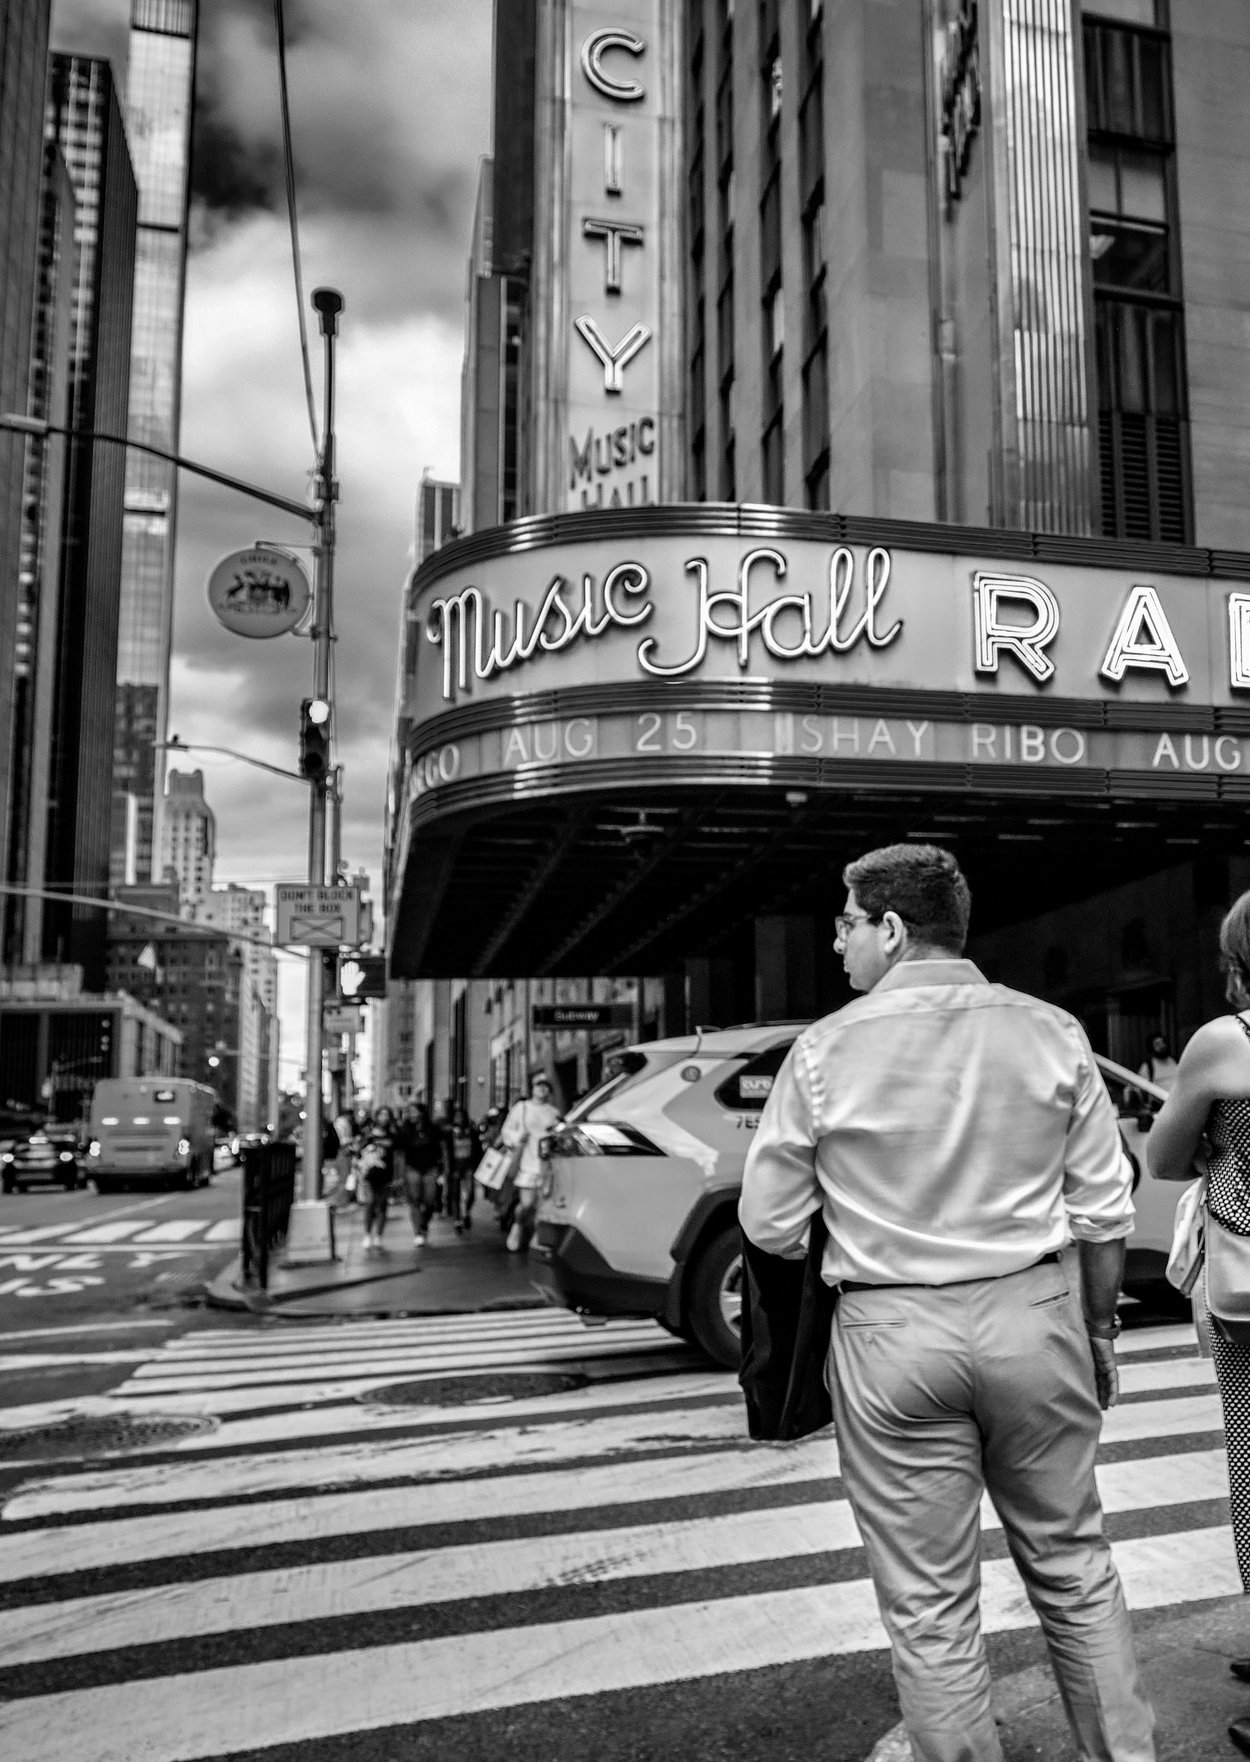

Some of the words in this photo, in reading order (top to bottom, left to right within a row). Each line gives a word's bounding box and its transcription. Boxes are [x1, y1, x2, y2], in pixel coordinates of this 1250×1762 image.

[575, 27, 653, 394] CITY
[426, 562, 653, 699] Music
[638, 547, 903, 676] Hall
[503, 717, 593, 769] AUG
[637, 713, 698, 753] 25
[971, 721, 1085, 765] RIBO
[1152, 733, 1242, 771] AUG
